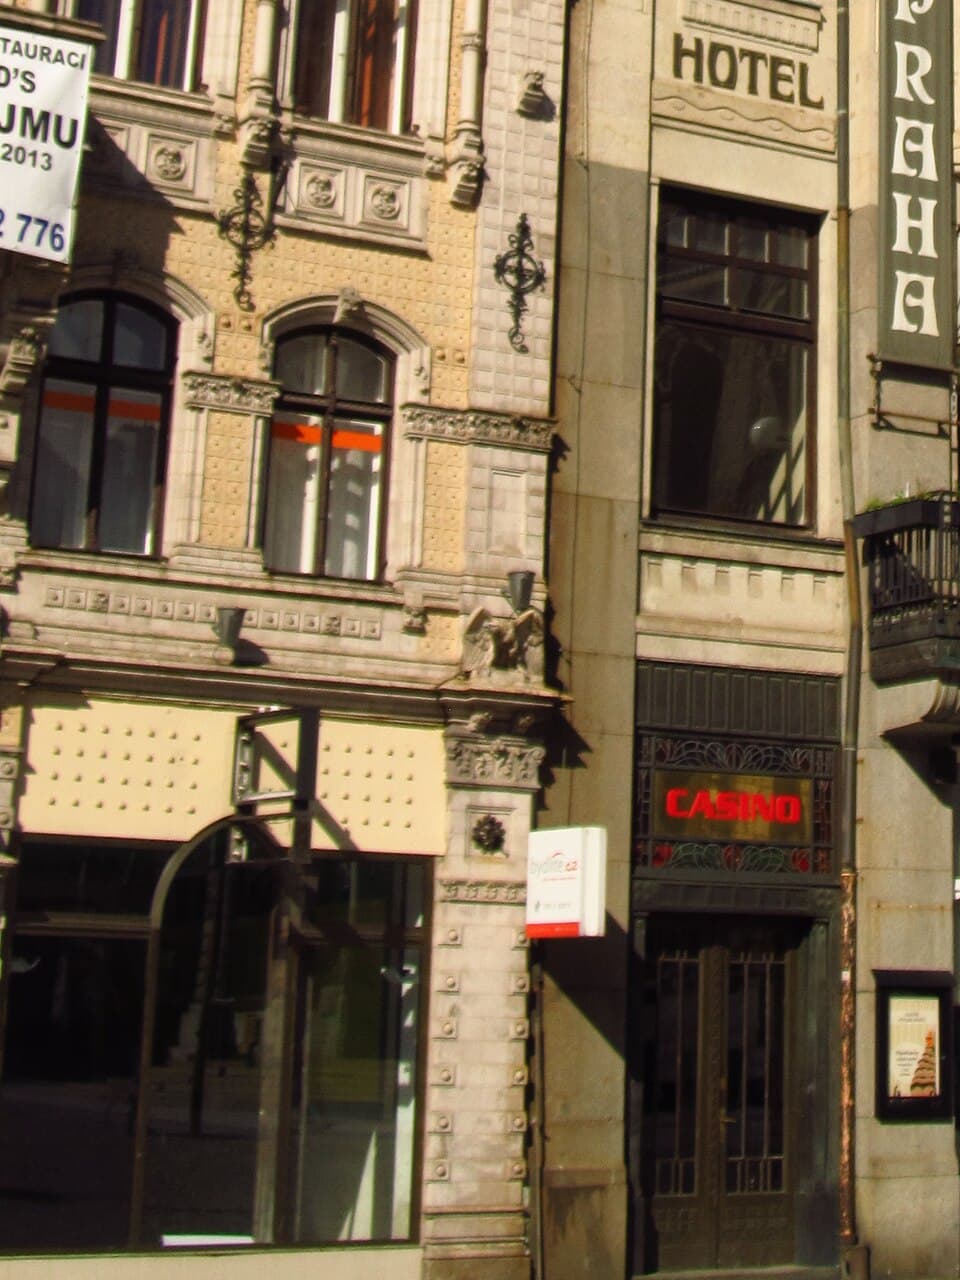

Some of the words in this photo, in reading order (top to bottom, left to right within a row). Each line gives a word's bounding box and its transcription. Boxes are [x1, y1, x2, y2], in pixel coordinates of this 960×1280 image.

[673, 31, 825, 111] HOTEL
[0, 143, 53, 171] 2013
[16, 213, 65, 252] 776
[665, 787, 802, 825] CASINO
